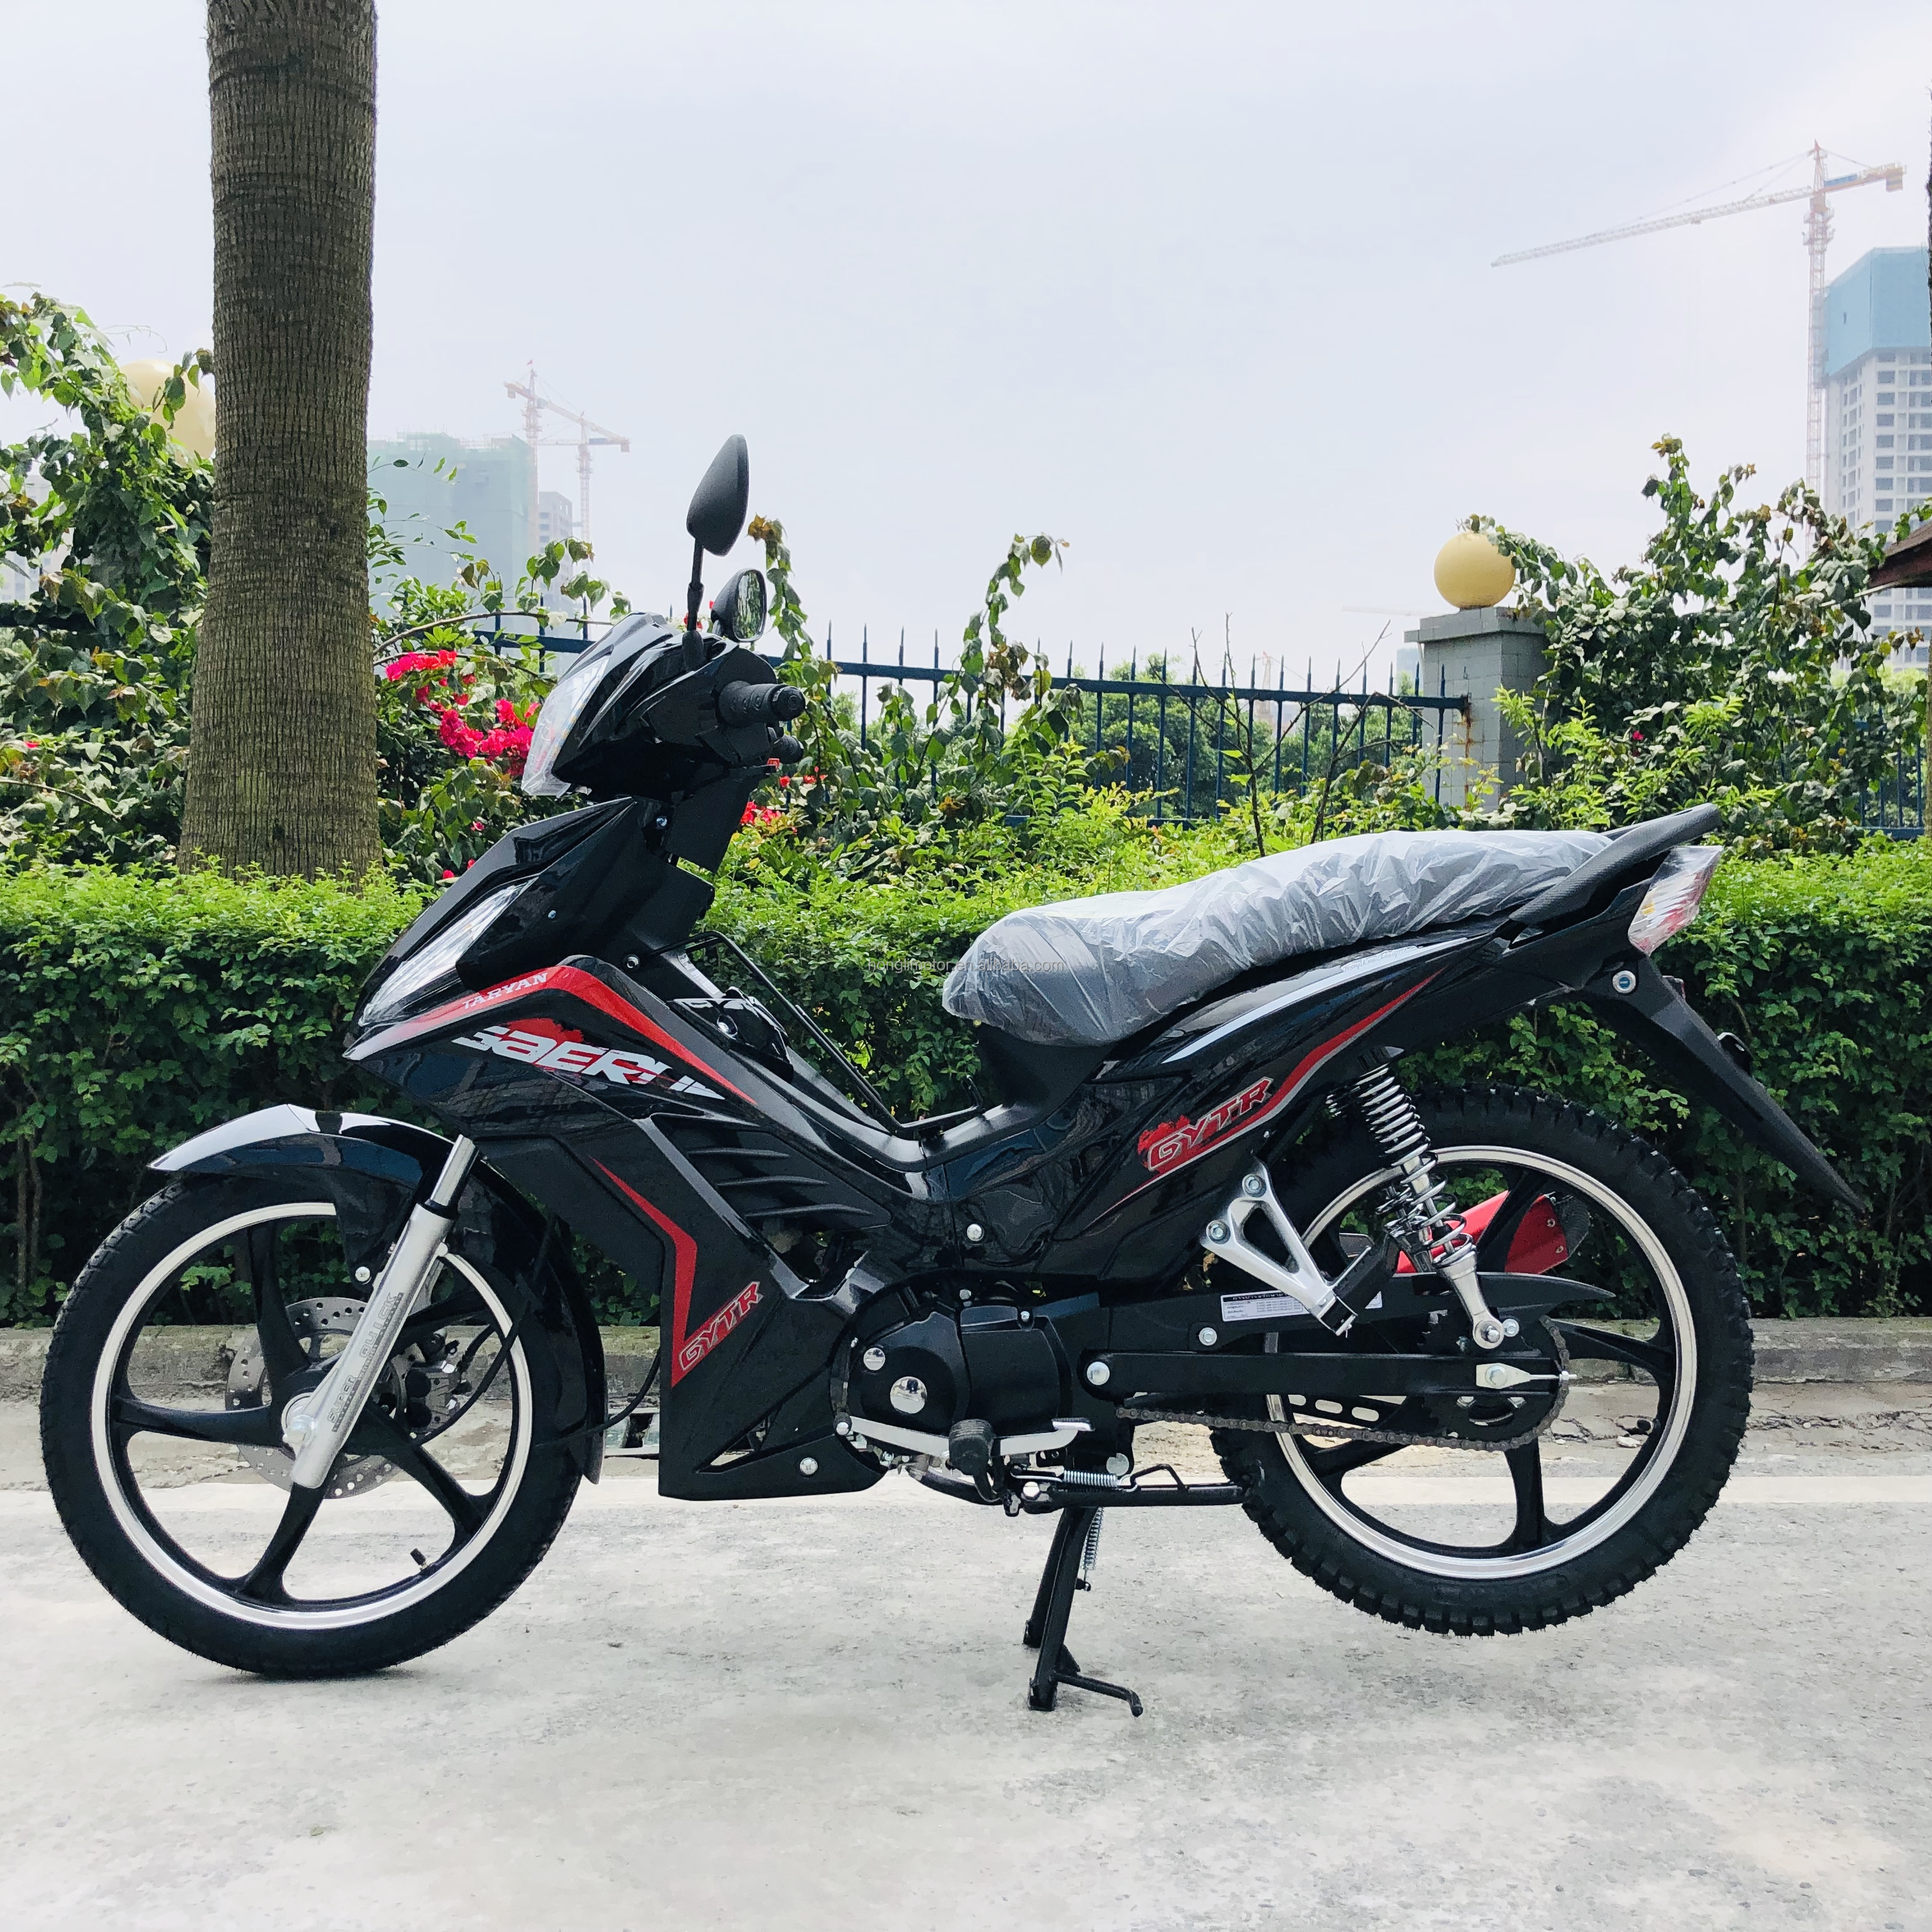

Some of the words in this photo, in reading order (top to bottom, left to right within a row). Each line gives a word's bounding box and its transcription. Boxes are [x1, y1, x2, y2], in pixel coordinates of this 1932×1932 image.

[462, 972, 548, 1009] TARYAN
[1147, 1077, 1274, 1171] GYTR
[326, 1374, 359, 1424] SUPER
[359, 1292, 397, 1358] QUICK
[678, 1281, 764, 1371] GYTR
